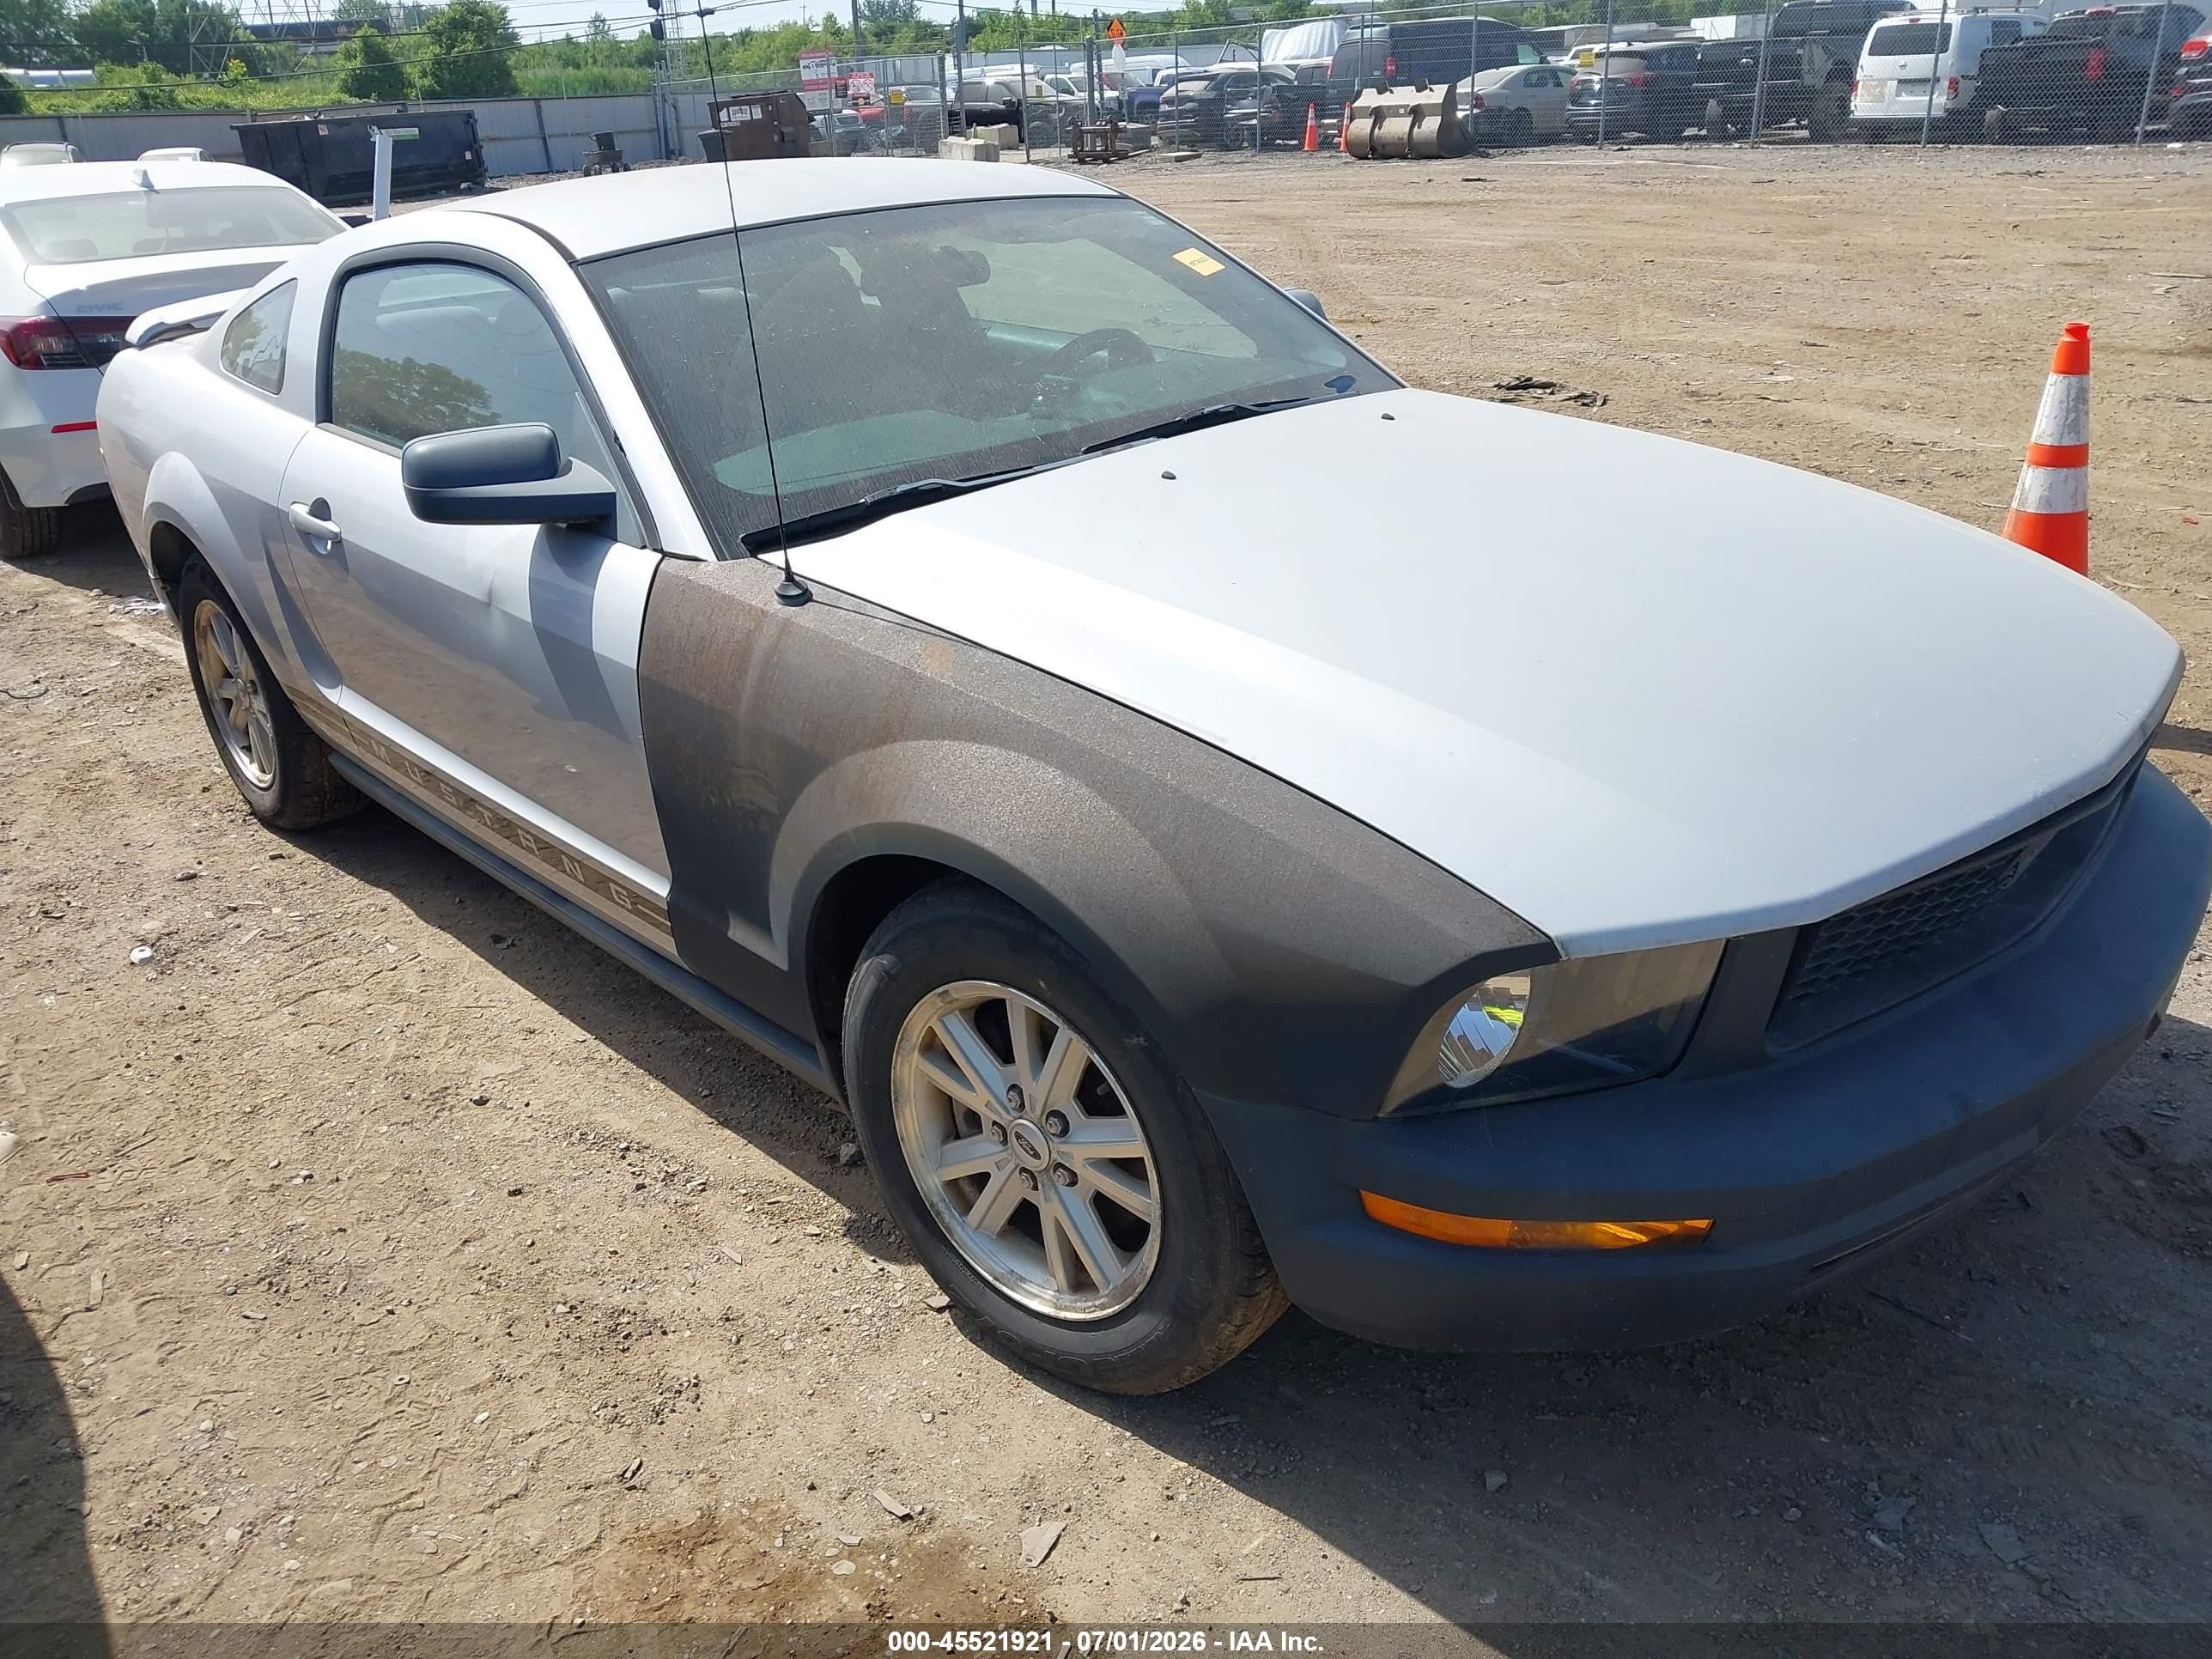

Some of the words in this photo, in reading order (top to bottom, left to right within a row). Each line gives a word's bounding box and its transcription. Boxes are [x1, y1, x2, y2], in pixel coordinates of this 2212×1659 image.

[76, 301, 125, 314] CIVIC
[369, 738, 634, 912] MUSTANG
[1018, 1138, 1035, 1156] Ford
